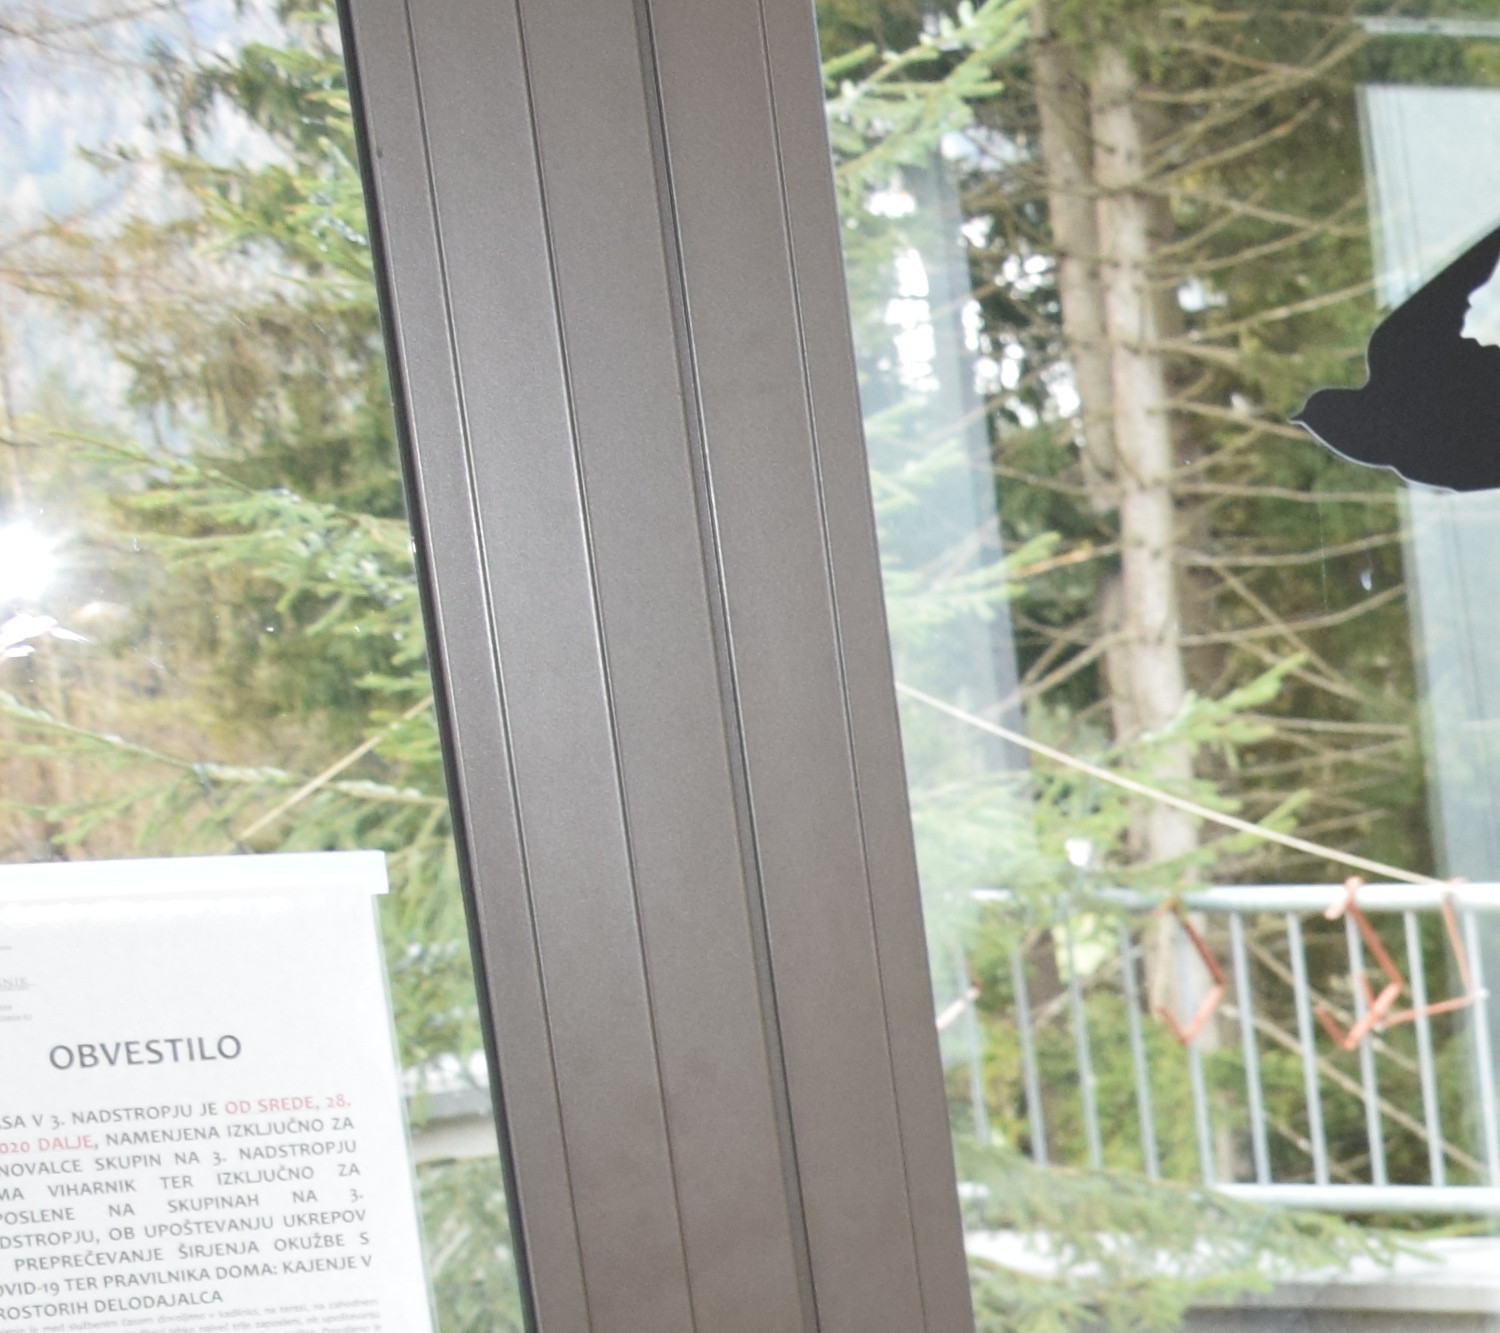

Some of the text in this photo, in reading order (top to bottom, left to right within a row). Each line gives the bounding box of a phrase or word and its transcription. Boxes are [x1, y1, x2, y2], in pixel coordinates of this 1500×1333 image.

[48, 1034, 242, 1071] OBVESTILO
[0, 1094, 351, 1130] SA V 3. NADSTROPJU JE OD SREDE, 28.
[38, 1135, 99, 1151] DALJE,
[105, 1125, 220, 1145] NAMENJENA
[226, 1117, 324, 1138] IZKLJUČNO
[332, 1116, 354, 1131] ZA
[94, 1154, 162, 1172] SKUPIN
[174, 1151, 200, 1165] NA
[212, 1151, 226, 1166] 3.
[238, 1140, 357, 1160] NADSTROPJU
[47, 1179, 136, 1197] VIHARNIK
[159, 1175, 193, 1190] TER
[216, 1165, 314, 1186] IZKLJUČNO
[337, 1163, 361, 1177] ZA
[0, 1207, 75, 1226] OSLENE
[108, 1202, 135, 1217] NA
[167, 1193, 259, 1214] SKUPINAH
[292, 1189, 318, 1204] NA
[108, 1226, 135, 1241] OB
[144, 1216, 274, 1239] UPOŠTEVANJU
[283, 1209, 366, 1228] UKREPOV
[14, 1231, 370, 1272] PREPREČEVANJE ŠIRJENJA OKUŽBE S
[63, 1276, 98, 1291] TER
[103, 1267, 211, 1289] PRAVILNIKA
[215, 1262, 278, 1280] DOMA:
[282, 1255, 357, 1274] KAJENJE
[360, 1255, 372, 1268] V
[94, 1290, 224, 1313] DELODAJALCA
